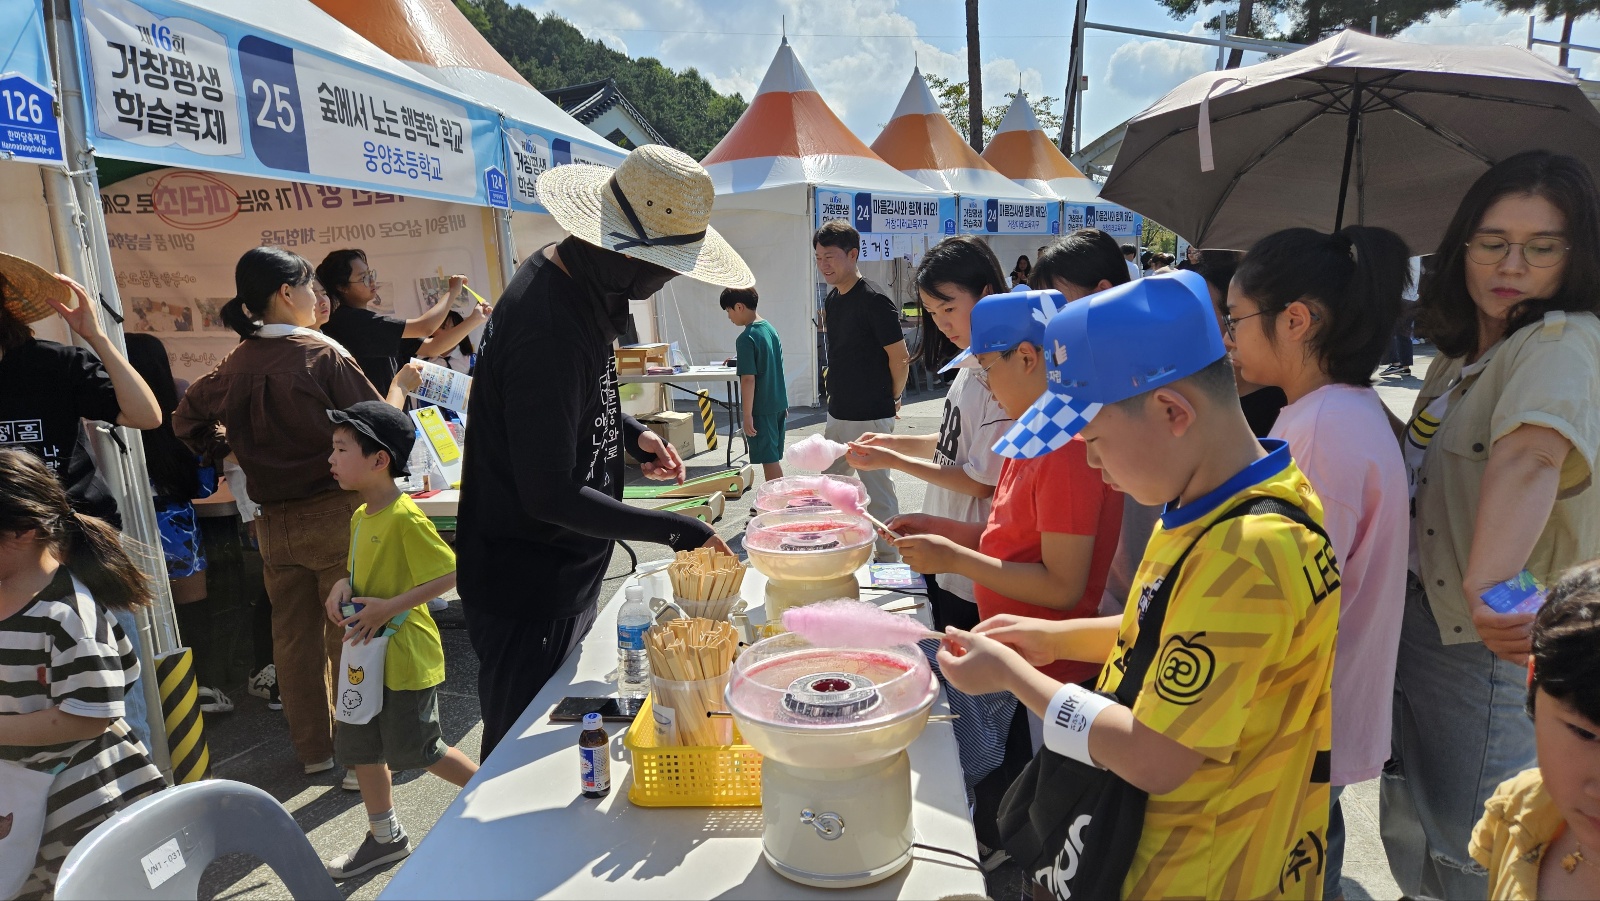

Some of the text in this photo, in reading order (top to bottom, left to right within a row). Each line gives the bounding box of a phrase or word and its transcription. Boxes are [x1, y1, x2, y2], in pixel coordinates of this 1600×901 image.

[106, 41, 224, 102] 거창평생
[2, 89, 43, 125] 126
[112, 88, 227, 145] 학습축제
[252, 78, 296, 133] 25
[316, 81, 464, 154] 숲에서 노는 행복한 학교
[362, 140, 444, 182] 웅양초등학교
[490, 173, 503, 190] 124
[856, 204, 870, 221] 24
[988, 209, 997, 222] 24
